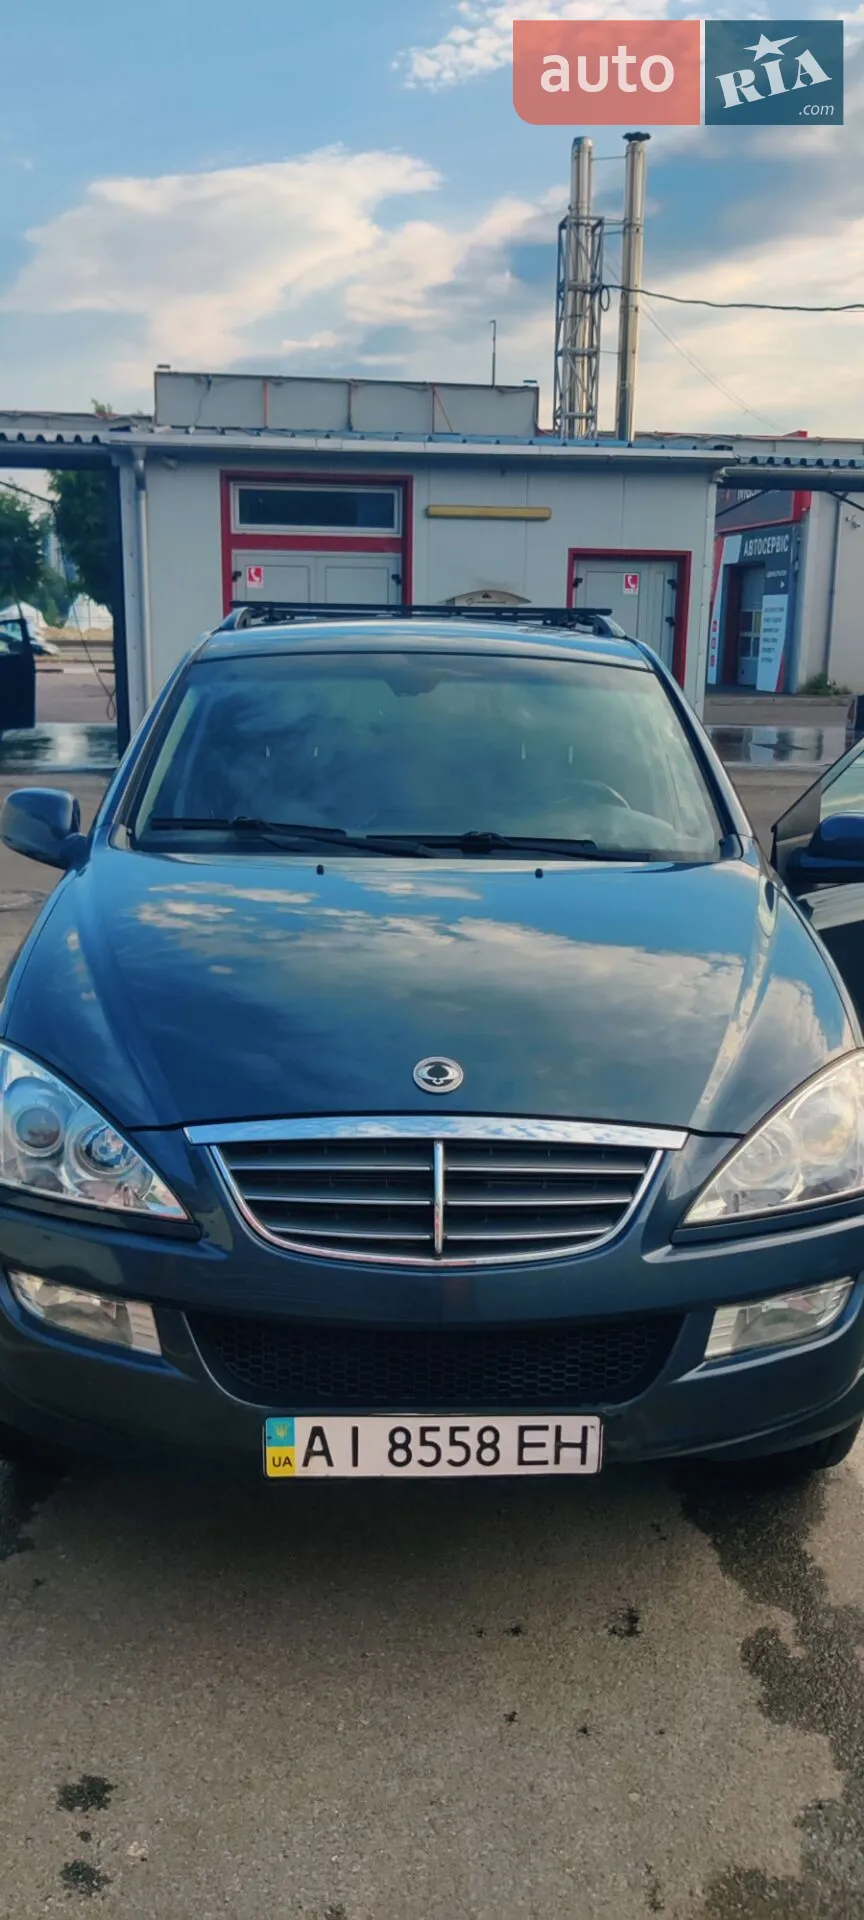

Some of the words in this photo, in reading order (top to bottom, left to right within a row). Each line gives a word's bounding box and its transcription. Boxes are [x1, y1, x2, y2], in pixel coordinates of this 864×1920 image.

[743, 534, 789, 557] АВТОСЕРВІС
[301, 1425, 359, 1468] AI
[387, 1425, 500, 1468] 8558
[516, 1424, 589, 1467] EH
[271, 1456, 293, 1469] UA
